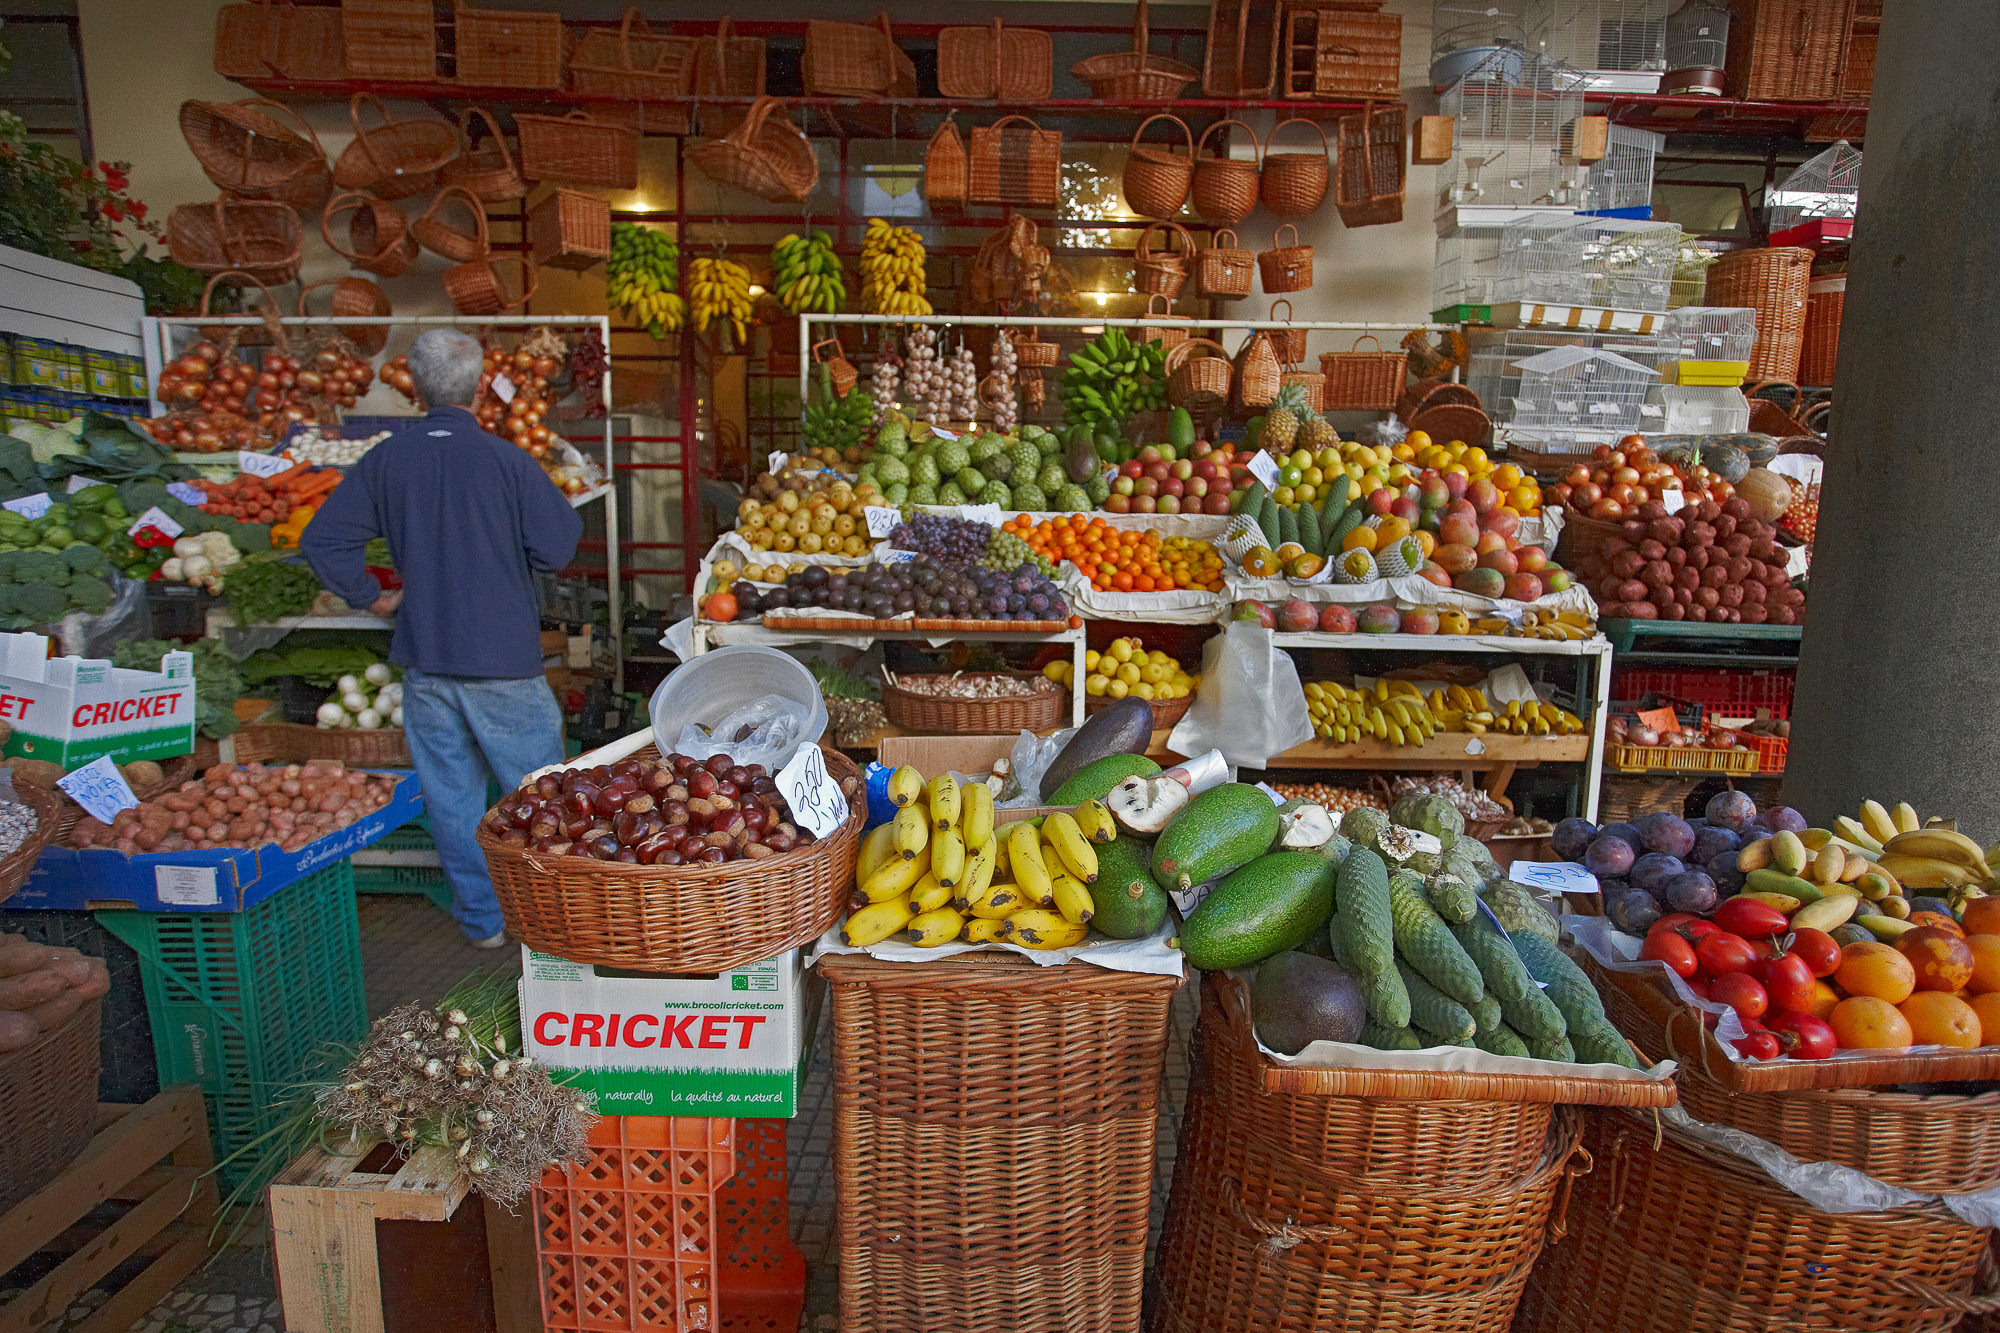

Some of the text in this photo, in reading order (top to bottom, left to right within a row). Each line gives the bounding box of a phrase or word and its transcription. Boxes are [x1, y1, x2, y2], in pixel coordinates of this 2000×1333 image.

[73, 692, 182, 728] CRICKET
[533, 1011, 767, 1049] CRICKET
[605, 1089, 654, 1105] naturally
[671, 1089, 784, 1106] la qualité au naturel
